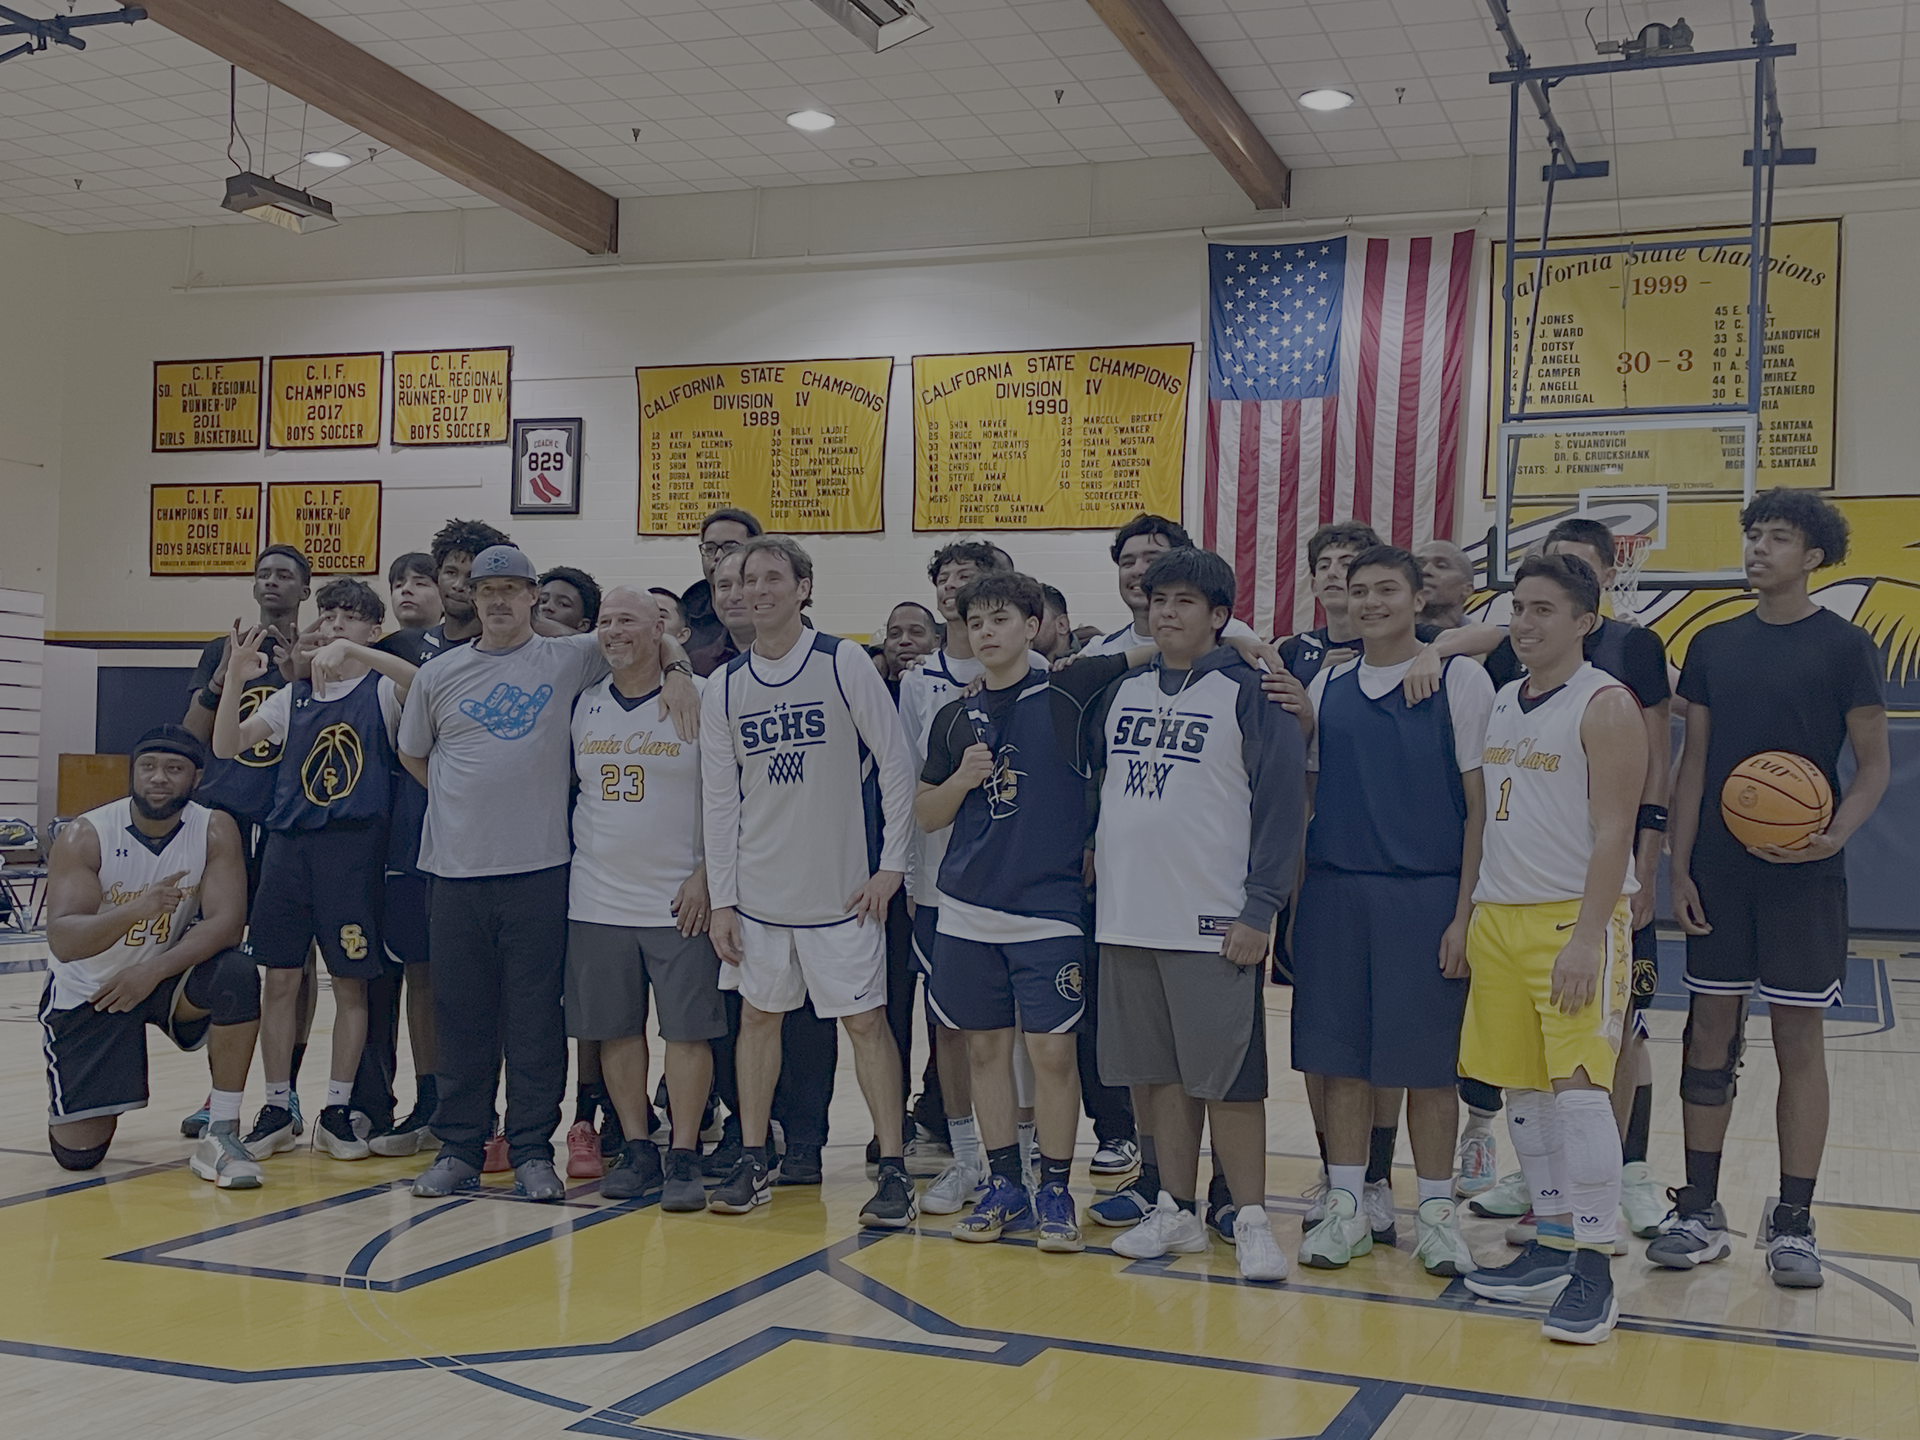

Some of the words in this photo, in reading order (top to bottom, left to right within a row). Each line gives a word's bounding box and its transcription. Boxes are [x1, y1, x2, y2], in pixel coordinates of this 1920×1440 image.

[1502, 254, 1613, 301] alfornia
[1631, 275, 1688, 296] 1999
[1715, 306, 1728, 316] 45
[1540, 314, 1574, 325] JONES
[1714, 320, 1725, 330] 12
[1553, 327, 1584, 338] WARD
[1714, 333, 1727, 344] 33
[1541, 341, 1575, 352] DOTSY
[1713, 348, 1727, 357] 40
[1542, 354, 1581, 365] ANGELL
[1713, 362, 1721, 371] 11
[1538, 367, 1581, 378] CAMPER
[449, 370, 503, 387] REGIONAL
[921, 362, 1013, 406] CALIFORNIA
[1027, 354, 1075, 374] STATE
[1089, 356, 1182, 396] CHAMPIONS
[1712, 375, 1726, 385] 44
[211, 380, 257, 396] REGIONAL
[996, 380, 1062, 399] DIVISION
[1086, 379, 1102, 395] IV
[1540, 381, 1579, 391] ANGELL
[285, 383, 366, 401] CHAMPIONS
[398, 388, 469, 407] RUNNER-UP
[473, 388, 492, 403] DIV
[643, 374, 725, 420] CALIFORNIA
[740, 367, 786, 385] STATE
[802, 370, 884, 413] CHAMPIONS
[1712, 389, 1726, 399] 30
[713, 393, 774, 411] DIVISION
[795, 391, 810, 407] IV
[1540, 394, 1595, 404] MADRIGAL
[182, 397, 237, 413] RUNNER-UP
[1027, 399, 1068, 416] 1990
[307, 405, 343, 421] 2017
[432, 406, 469, 422] 2017
[193, 414, 221, 429] 2011
[743, 411, 780, 427] 1989
[979, 420, 1007, 428] TARVER
[1061, 416, 1073, 426] 23
[1084, 416, 1120, 425] MARCELL
[1131, 413, 1163, 424] BRICKEY
[1061, 427, 1073, 436] 12
[1083, 427, 1103, 436] EVAN
[1113, 425, 1151, 435] SWANGER
[1770, 420, 1813, 430] SANTANA
[286, 426, 314, 441] BOYS
[320, 424, 364, 440] SOCCER
[410, 424, 440, 440] BOYS
[446, 422, 491, 439] SOCCER
[670, 431, 683, 439] ART
[692, 430, 724, 439] SANTANA
[949, 431, 973, 440] BRUCE
[983, 430, 1018, 439] HOWARTH
[160, 432, 185, 446] GIRLS
[194, 429, 254, 444] BASKETBALL
[1061, 439, 1072, 447] 34
[1084, 438, 1110, 446] ISAIAH
[1120, 436, 1155, 445] MUSTAFA
[1769, 433, 1812, 443] SANTANA
[534, 439, 553, 449] COACH
[555, 441, 559, 449] C
[701, 440, 733, 449] CLEMONS
[928, 443, 939, 452] 33
[949, 441, 982, 450] ANTHONY
[1567, 438, 1627, 449] CVIJANOVICH
[949, 452, 982, 461] ANTHONY
[992, 451, 1027, 460] MAESTAS
[1061, 449, 1072, 458] 30
[1082, 449, 1096, 457] TIM
[1585, 450, 1650, 461] CRUICKSHANK
[1769, 445, 1818, 456] SCHOFIELD
[529, 452, 564, 471] 829
[949, 463, 969, 472] CHRIS
[979, 462, 998, 471] COLE
[1061, 460, 1071, 468] 10
[1081, 459, 1100, 468] DAVE
[1111, 458, 1151, 467] ANDERSON
[1771, 458, 1816, 468] SANTANA
[790, 469, 821, 477] ANTHONY
[1061, 471, 1068, 479] 11
[1114, 469, 1140, 478] BROWN
[949, 484, 963, 492] ART
[973, 483, 1002, 492] BARRON
[1059, 481, 1070, 490] 50
[1081, 481, 1103, 490] CHRIS
[1113, 480, 1140, 489] HAIDET
[960, 494, 984, 503] OSCAR
[993, 494, 1022, 503] ZAVALA
[960, 505, 999, 513] FRANCISCO
[1010, 504, 1045, 513] SANTANA
[1080, 502, 1100, 511] LULU
[1110, 502, 1145, 511] SANTANA
[157, 508, 209, 521] CHAMPIONS
[296, 508, 351, 521] RUNNER-UP
[798, 509, 831, 518] SANTANA
[188, 524, 219, 539] 2019
[329, 523, 341, 536] VII
[156, 543, 183, 555] BOYS
[186, 542, 251, 555] BASKETBALL
[304, 538, 341, 554] 2020
[318, 555, 365, 568] SOCCER
[740, 709, 826, 749] SCHS
[1113, 715, 1209, 754] SCHS
[578, 730, 622, 756] Santa
[624, 730, 681, 757] Clara
[1515, 737, 1562, 772] Clara
[601, 764, 645, 803] 23
[1495, 777, 1512, 821] 1
[124, 912, 171, 946] 24
